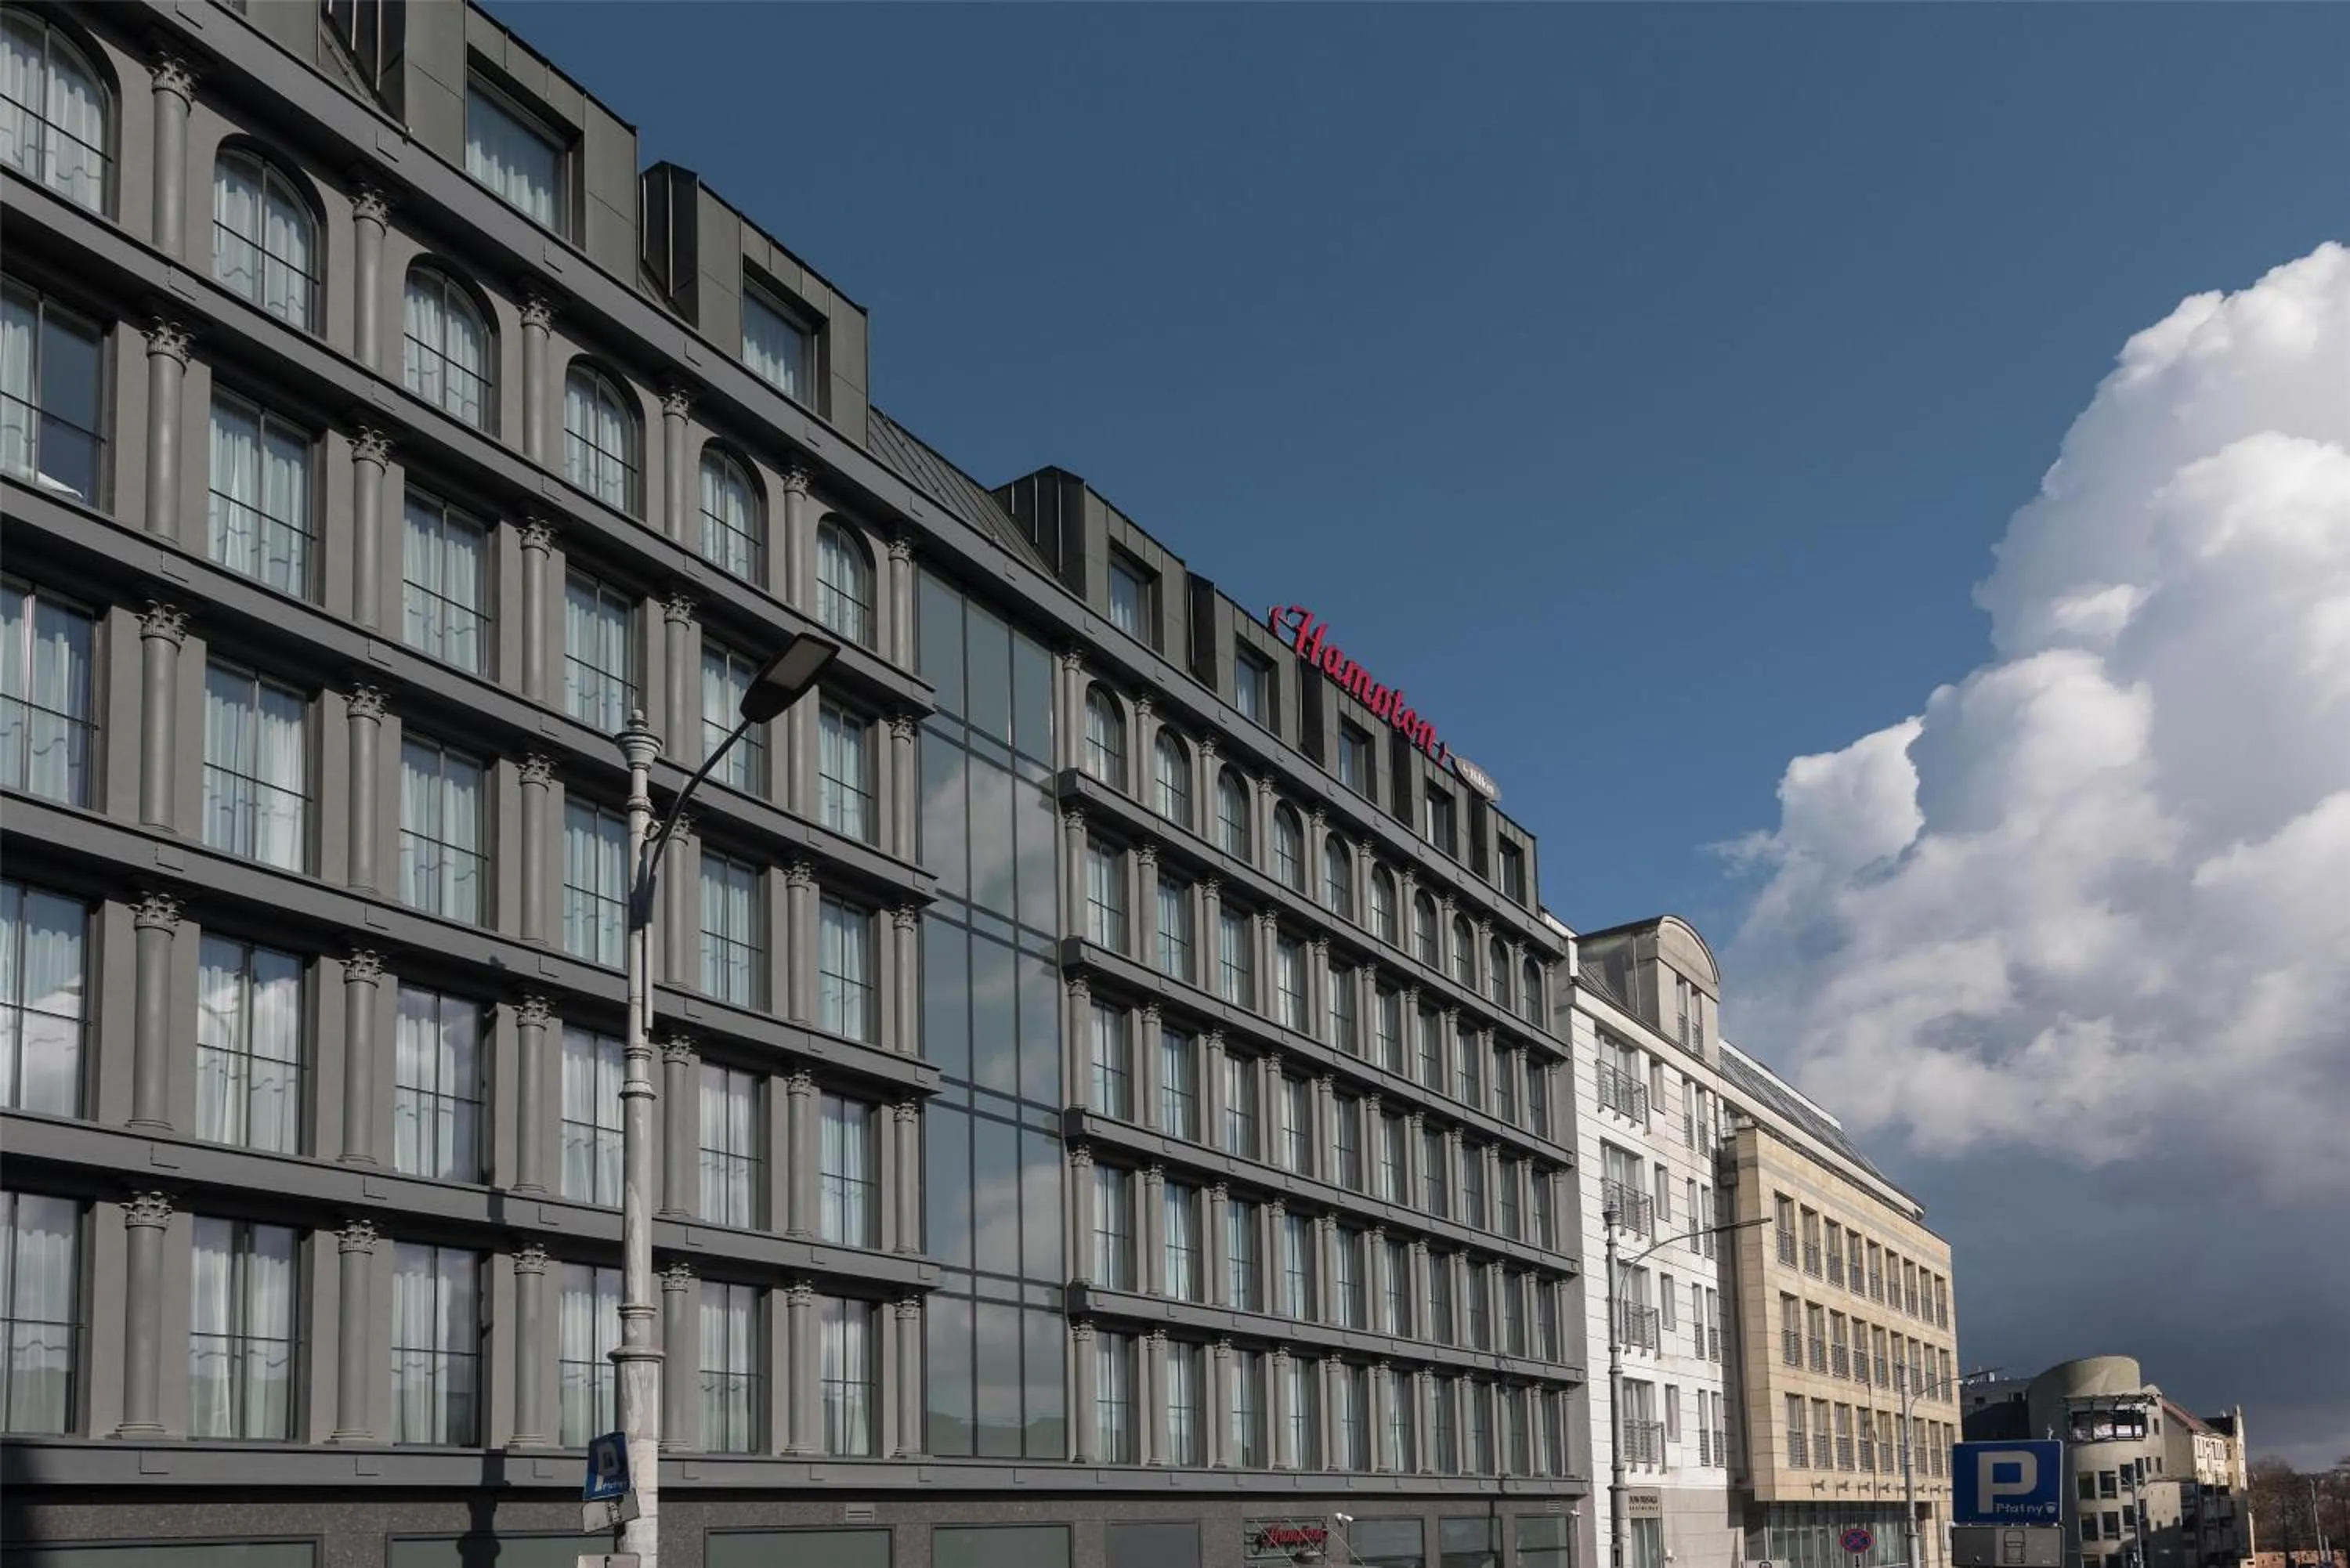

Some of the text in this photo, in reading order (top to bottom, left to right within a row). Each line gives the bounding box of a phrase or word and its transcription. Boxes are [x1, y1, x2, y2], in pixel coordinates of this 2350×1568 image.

[1267, 605, 1448, 768] Hampton
[595, 1442, 620, 1492] P
[1978, 1451, 2037, 1514] P
